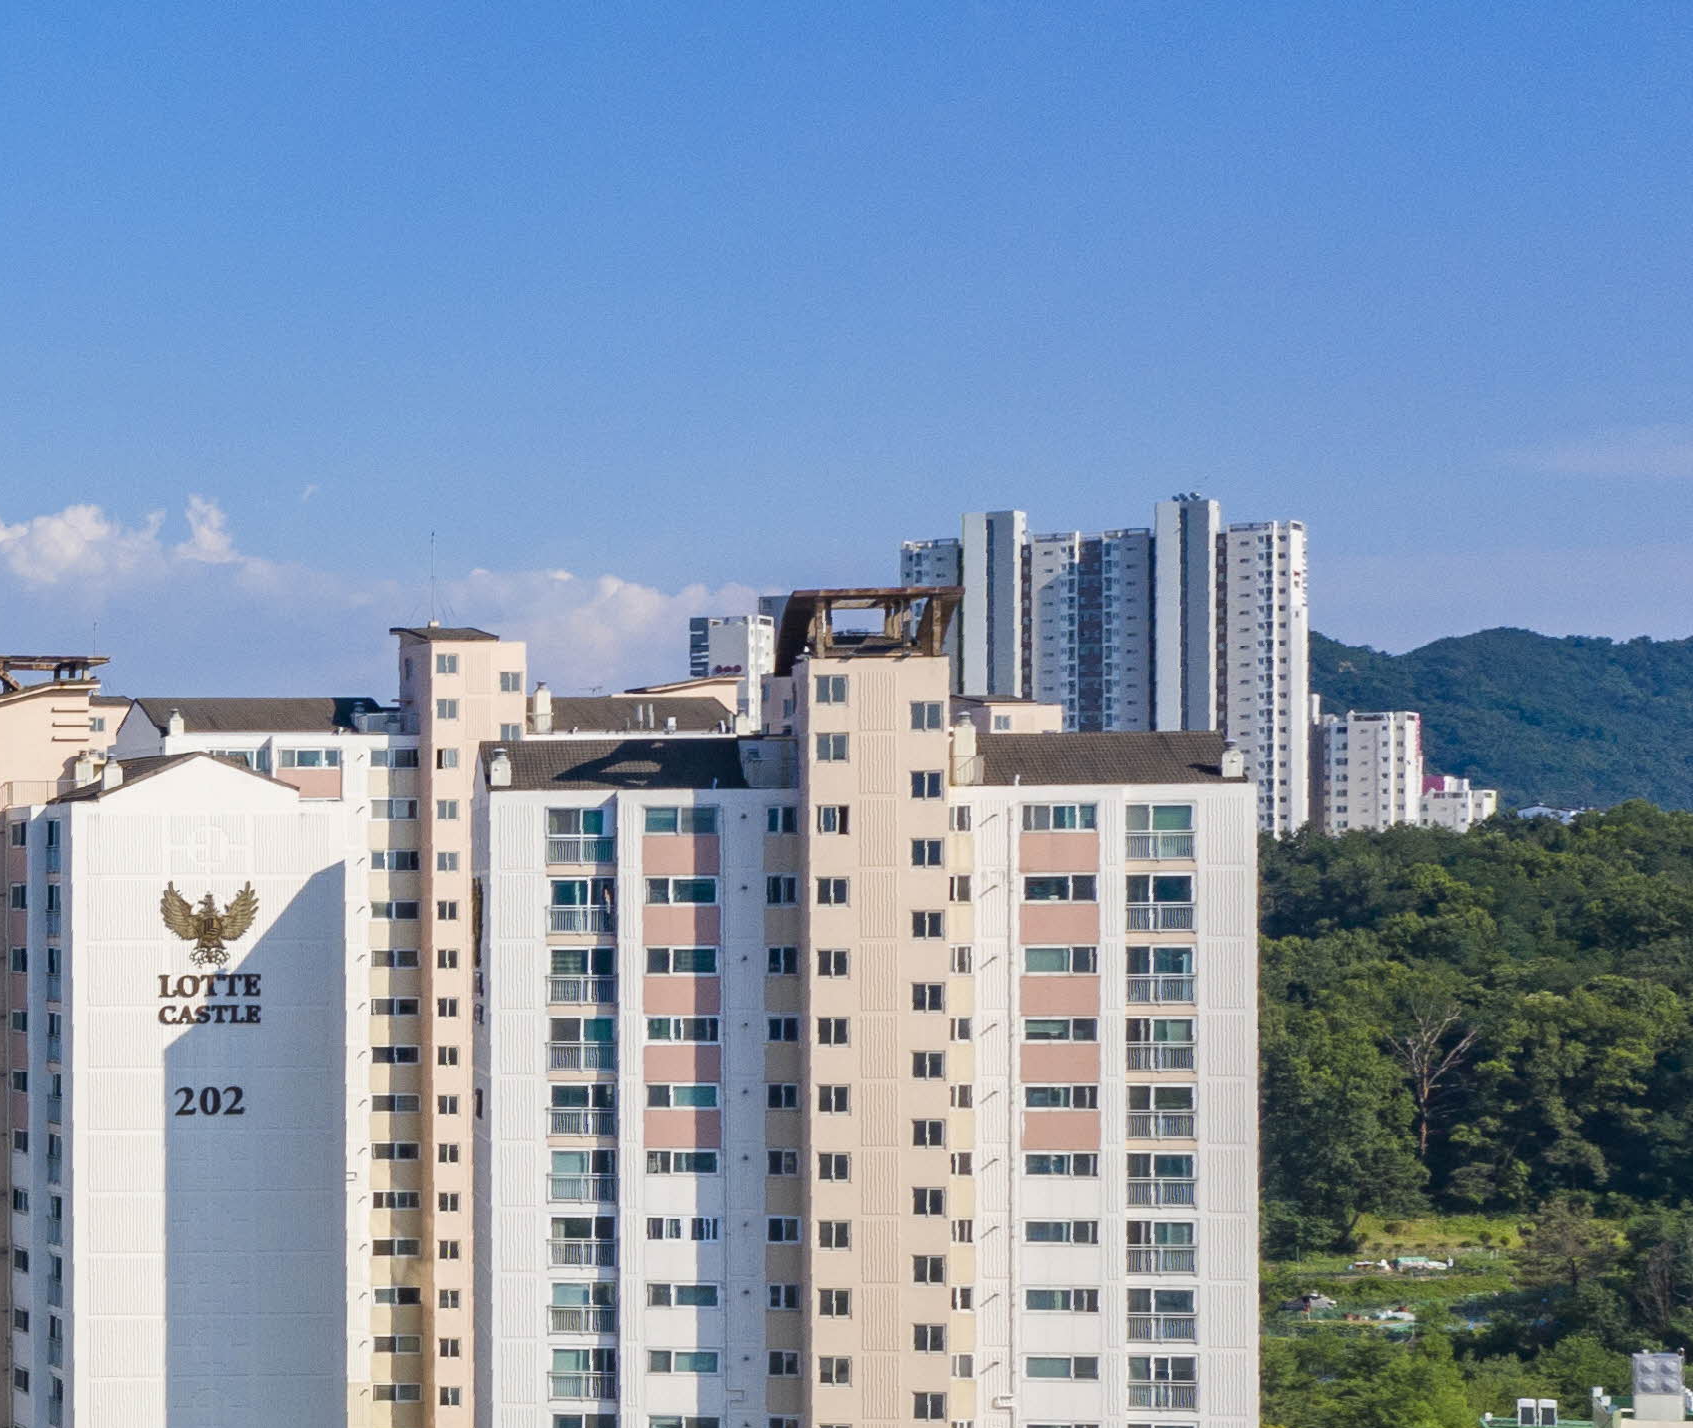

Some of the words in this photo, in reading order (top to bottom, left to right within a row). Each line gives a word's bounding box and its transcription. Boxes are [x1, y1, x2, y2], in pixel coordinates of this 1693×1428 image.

[157, 973, 262, 998] LOTTE
[157, 1004, 262, 1025] CASTLE
[173, 1085, 246, 1116] 202
